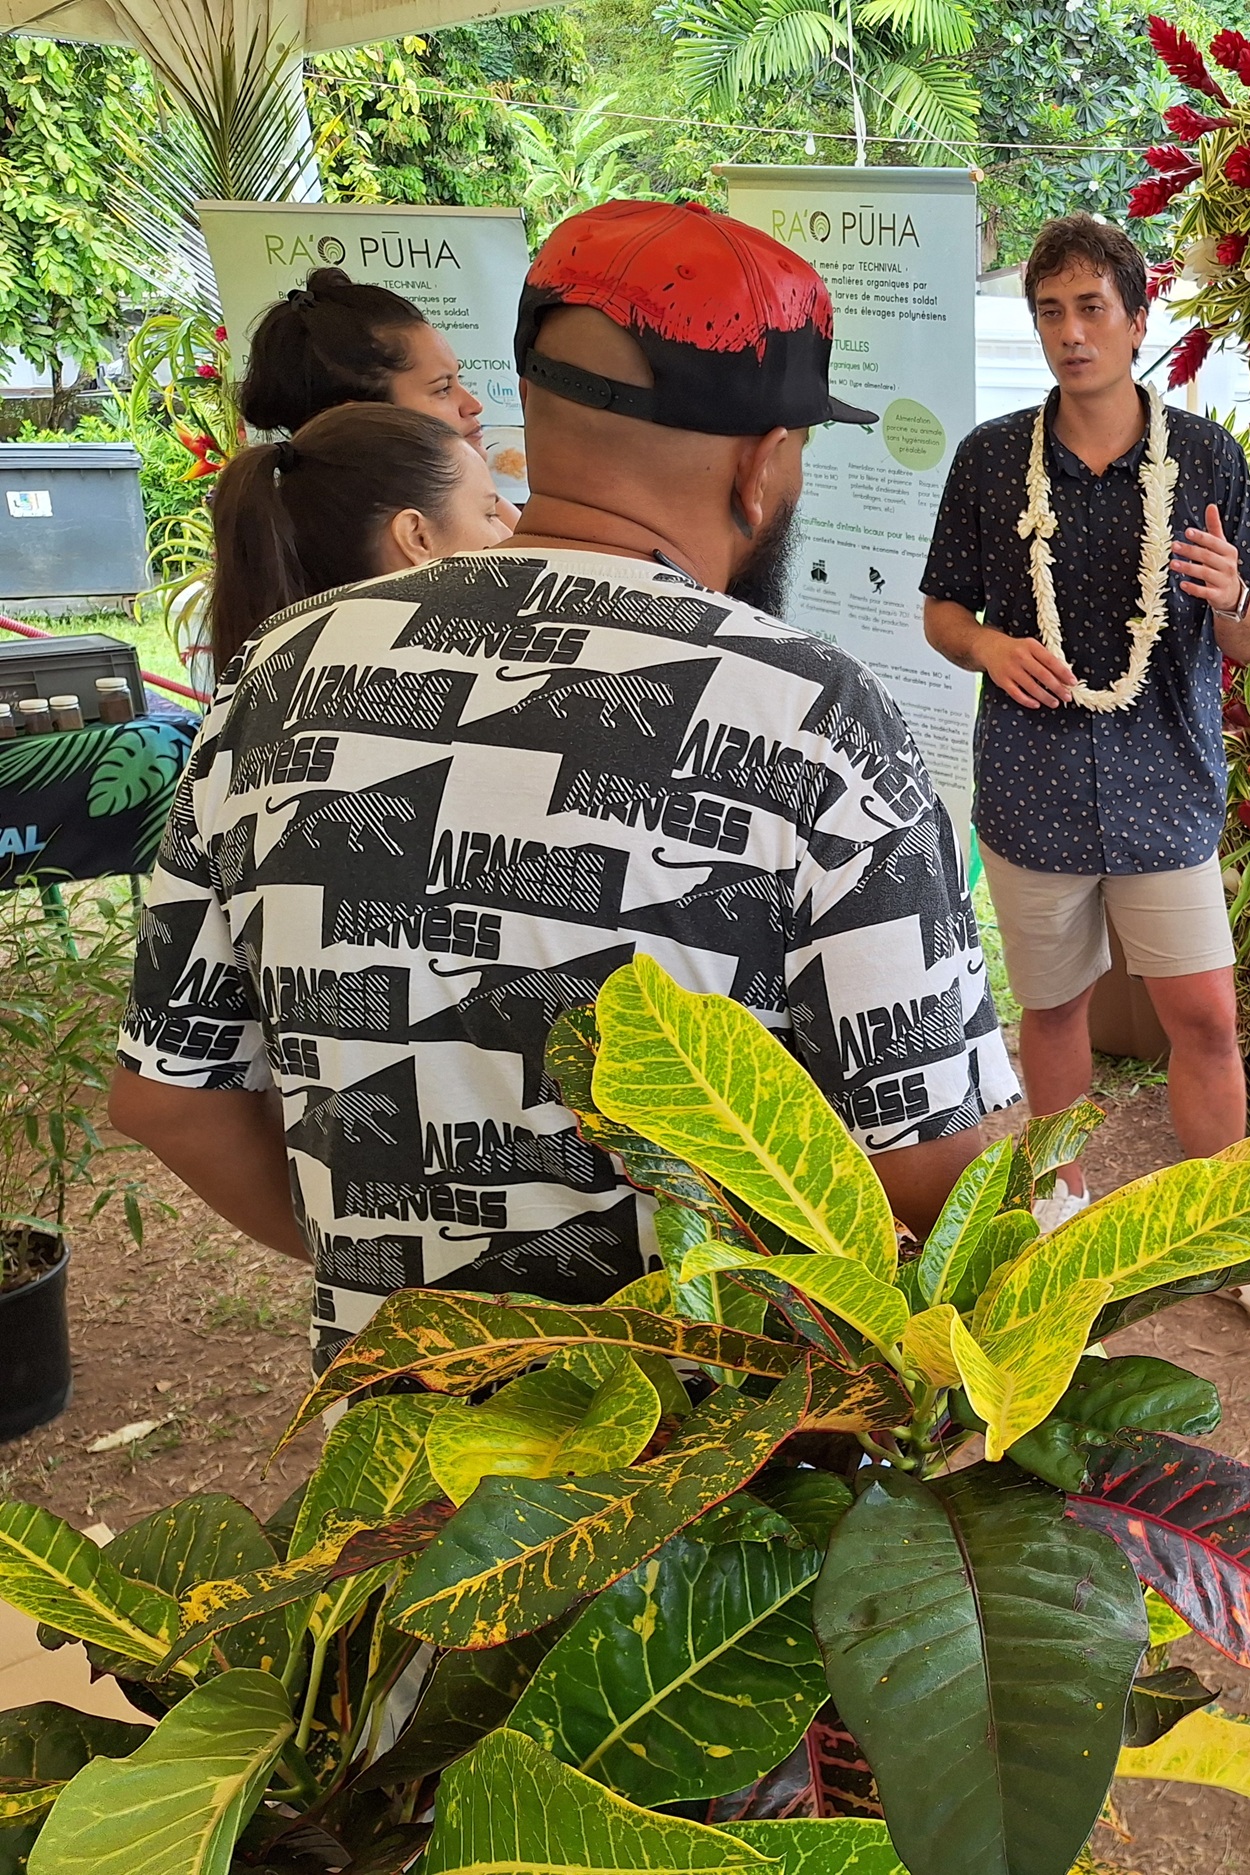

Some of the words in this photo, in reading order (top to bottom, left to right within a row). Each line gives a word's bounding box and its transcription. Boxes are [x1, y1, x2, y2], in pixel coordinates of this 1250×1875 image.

[842, 205, 920, 248] PŪHA
[359, 231, 461, 270] PŪHA
[819, 261, 839, 270] mené
[842, 262, 855, 272] par
[858, 261, 902, 273] TECHNIVAL
[383, 280, 432, 289] TECHNIVAL
[831, 276, 864, 286] matières
[866, 279, 910, 289] organiques
[913, 282, 927, 292] par
[835, 290, 858, 300] larves
[861, 292, 871, 301] de
[873, 293, 909, 304] mouches
[912, 295, 938, 306] soldat
[444, 308, 470, 316] soldat
[844, 305, 858, 315] des
[860, 306, 896, 319] élevages
[898, 309, 947, 322] polynésiens
